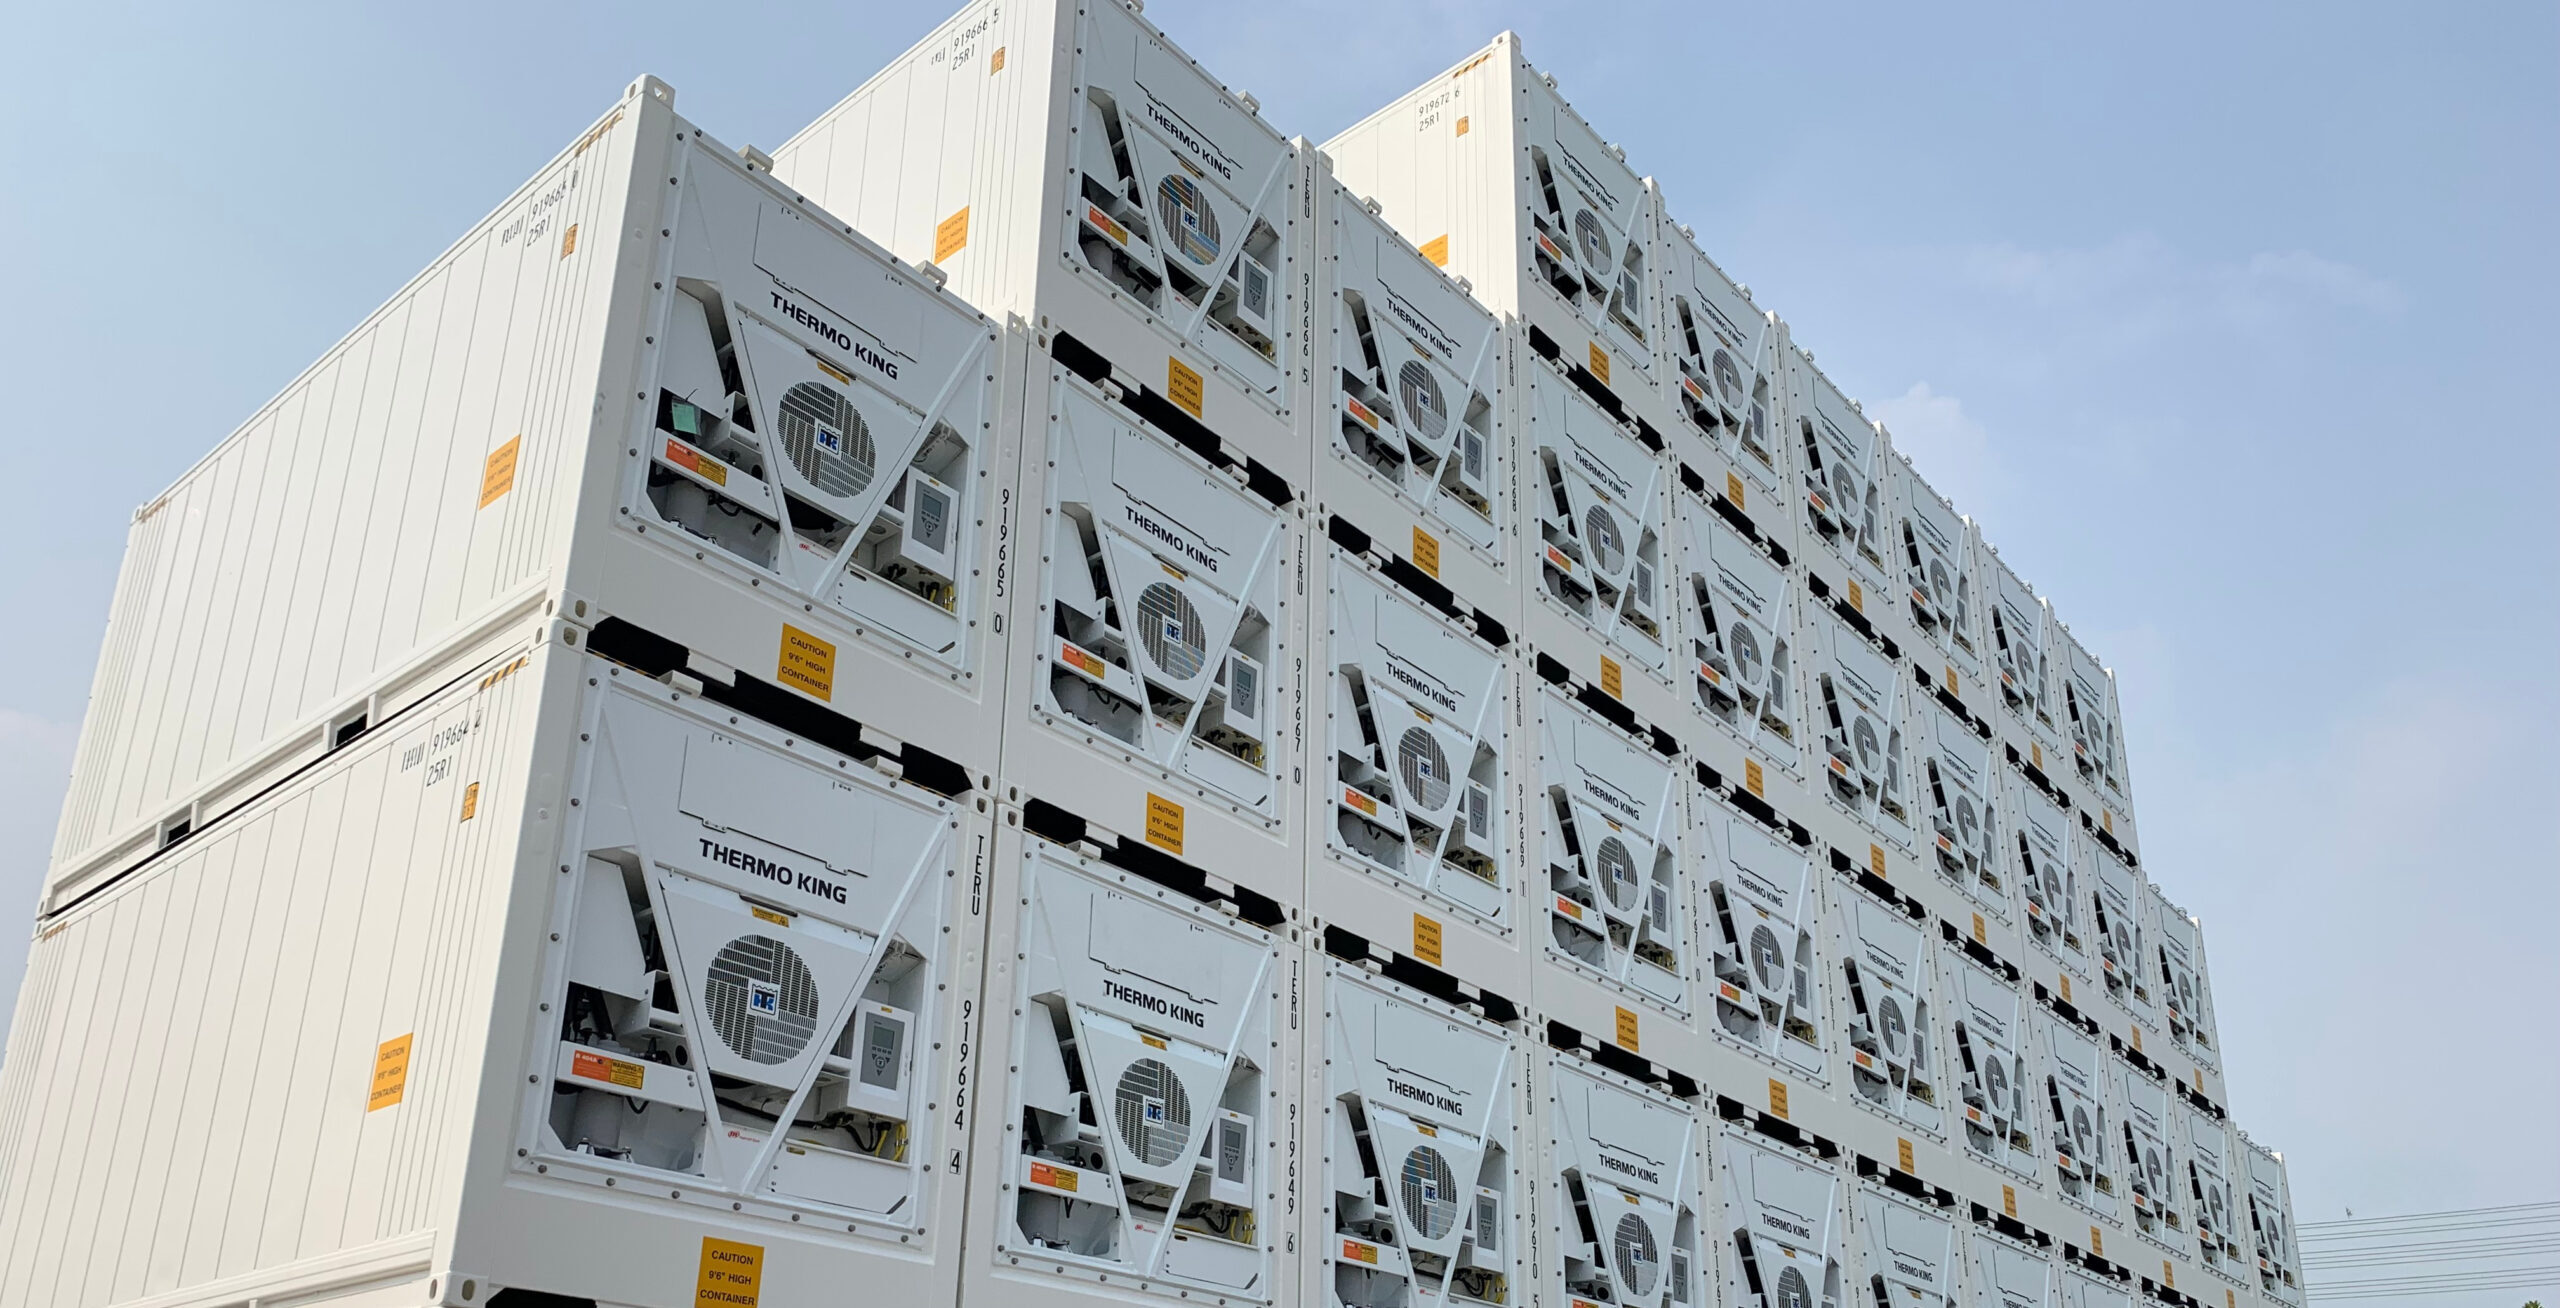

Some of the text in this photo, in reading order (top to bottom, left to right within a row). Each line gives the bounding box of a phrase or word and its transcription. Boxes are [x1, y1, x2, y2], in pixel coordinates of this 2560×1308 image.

[953, 8, 999, 53] 919666 5
[952, 44, 976, 71] 25R1
[1419, 92, 1450, 117] 919672
[1419, 112, 1440, 132] 25R1
[1146, 103, 1232, 181] THERMO KING
[1562, 155, 1615, 212] THERMO KING
[527, 215, 551, 247] 25R1
[1301, 273, 1310, 357] 919666
[1386, 298, 1453, 359] THERMO KING
[770, 290, 851, 351] THERMO
[854, 342, 900, 380] KING
[1173, 364, 1199, 387] CAUTION
[1301, 367, 1308, 383] 5
[1169, 387, 1202, 412] CONTAINER
[1183, 384, 1199, 399] HIGH
[1574, 451, 1627, 501] THERMO KING
[1125, 506, 1219, 573] THERMO KING
[994, 488, 1010, 634] 919665 0
[1718, 573, 1763, 615] THERMO KING
[788, 652, 826, 675] 9'6" HIGH
[790, 637, 828, 659] CAUTION
[1294, 534, 1304, 784] TERU 919667 0
[781, 666, 829, 694] CONTAINER
[1385, 662, 1457, 712] THERMO KING
[426, 755, 453, 787] 25R1
[1151, 802, 1180, 820] CAUTION
[1583, 779, 1641, 821] THERMO KING
[1147, 828, 1182, 849] CONTAINER
[1164, 821, 1180, 834] HIGH
[1517, 783, 1526, 869] 919669
[700, 838, 848, 905] THERMO KING
[1738, 874, 1783, 908] THERMO KING
[1418, 921, 1439, 935] CAUTION
[1427, 936, 1439, 946] HIGH
[1415, 943, 1442, 960] CONTAINER
[952, 834, 986, 1173] TERU 919664 4
[1103, 979, 1206, 1029] THERMO KING
[381, 1046, 405, 1062] CAUTION
[388, 1066, 402, 1077] HIGH
[1526, 1053, 1534, 1116] TERU
[370, 1084, 402, 1102] CONTAINER
[1287, 961, 1298, 1252] TERU 919649 6
[1386, 1078, 1463, 1116] THERMO KING
[1706, 1125, 1714, 1182] TERU
[1599, 1154, 1659, 1185] THERMO KING
[1529, 1180, 1538, 1279] 919670
[1762, 1213, 1811, 1240] THERMO KING
[711, 1250, 754, 1266] CAUTION
[1893, 1260, 1934, 1284] THERMO KING
[708, 1270, 752, 1287] 9'6" HIGH
[699, 1288, 755, 1306] CONTAINER
